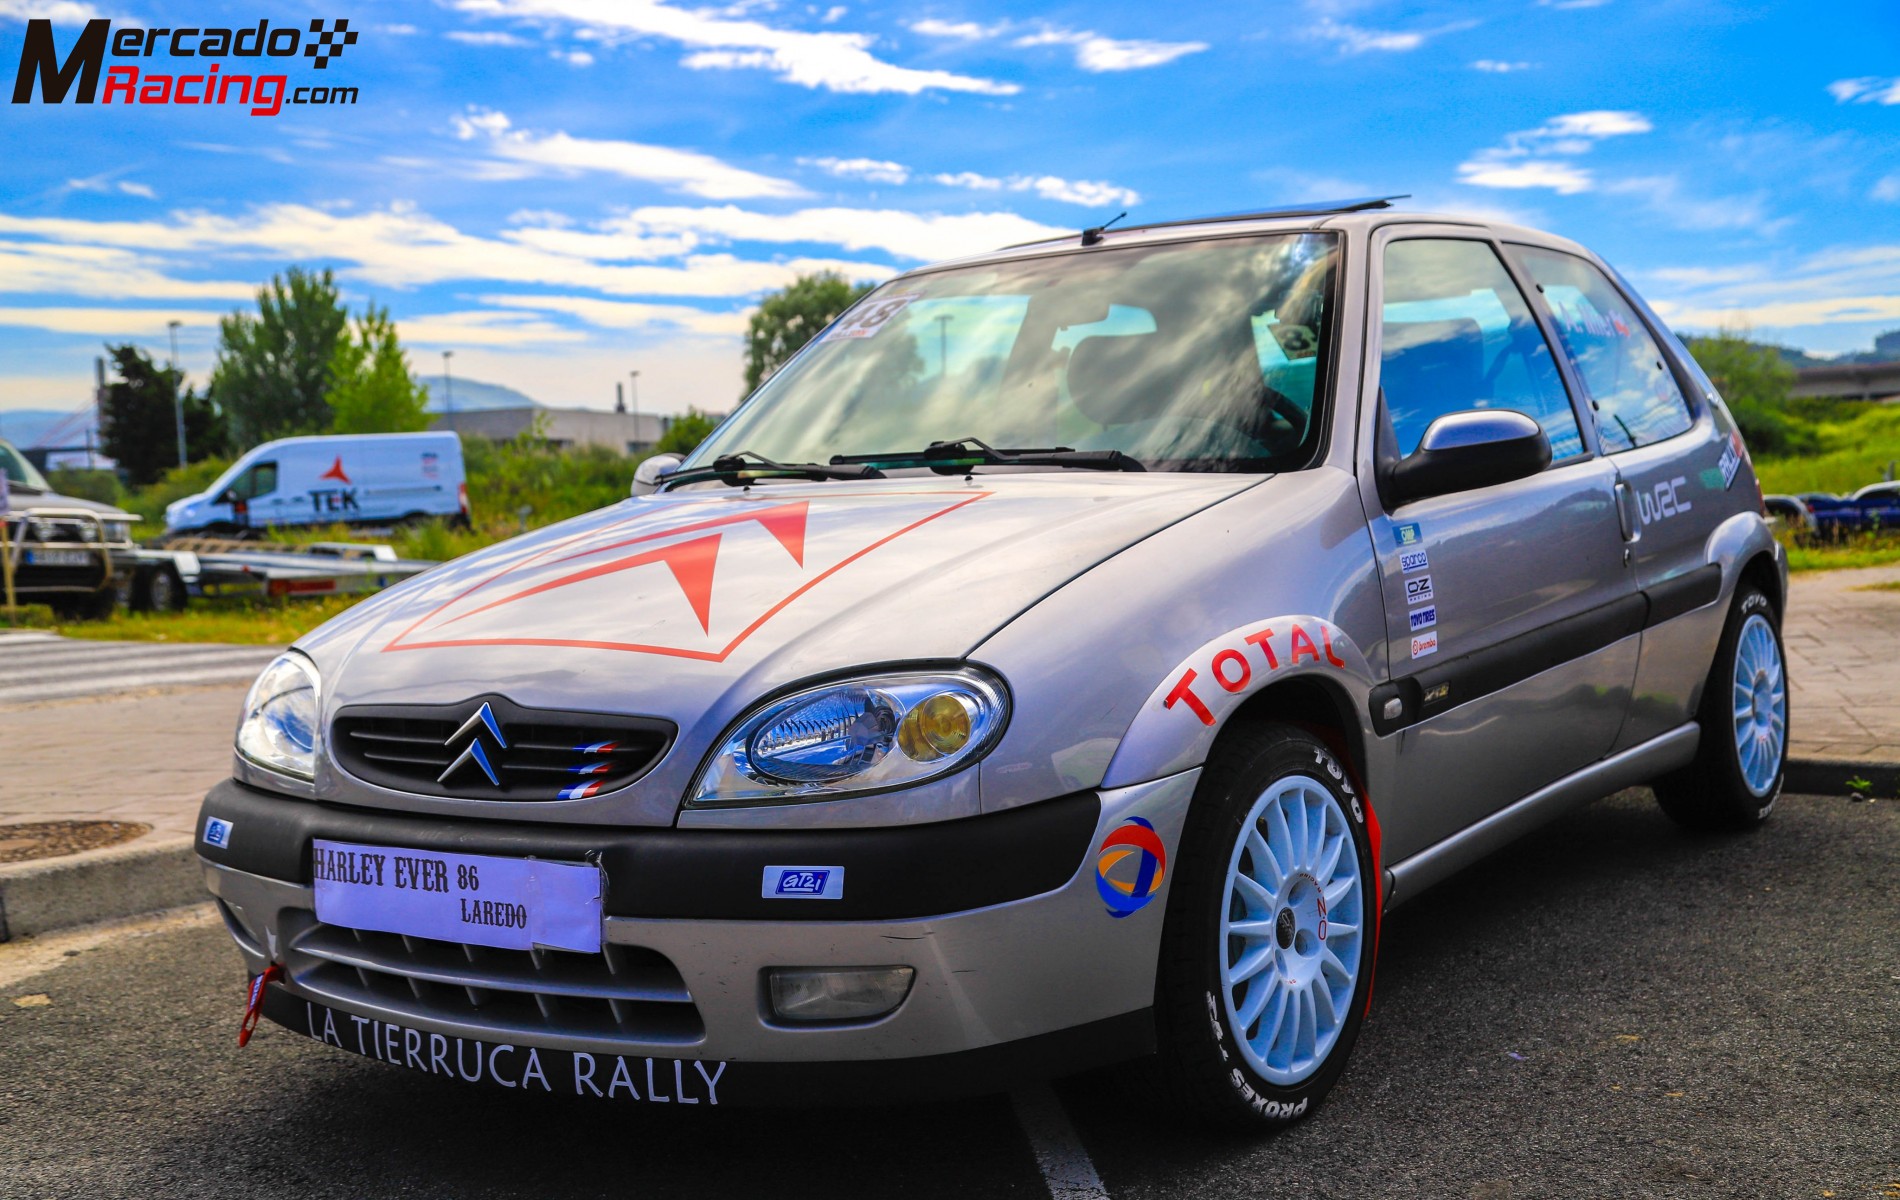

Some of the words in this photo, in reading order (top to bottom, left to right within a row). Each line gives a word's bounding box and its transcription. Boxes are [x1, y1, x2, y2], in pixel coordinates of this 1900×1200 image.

[308, 487, 360, 513] TEK
[1636, 476, 1692, 526] WRC
[1401, 552, 1427, 570] sparco
[1410, 611, 1423, 628] TOYO
[1422, 609, 1435, 625] TIRES
[1164, 623, 1345, 727] TOTAL
[1314, 746, 1364, 824] TOYO
[313, 847, 386, 887] HARLEY
[394, 856, 449, 893] EVER
[457, 863, 480, 891] 86
[461, 898, 528, 930] LAREDO
[306, 1001, 343, 1049] LA
[350, 1014, 551, 1092] TIERRUCA
[574, 1051, 727, 1105] RALLY
[1229, 1067, 1308, 1119] PROXES
